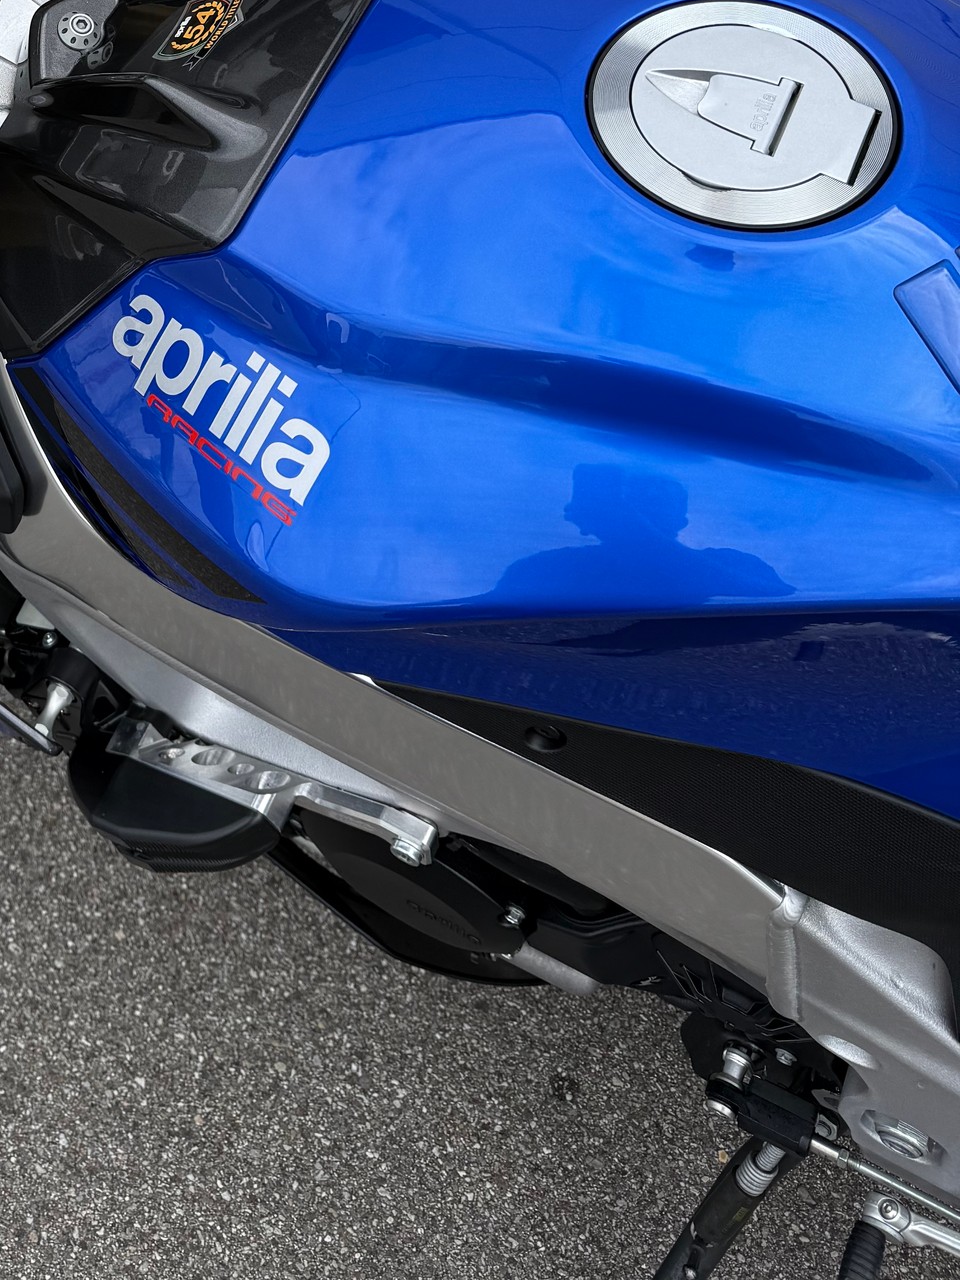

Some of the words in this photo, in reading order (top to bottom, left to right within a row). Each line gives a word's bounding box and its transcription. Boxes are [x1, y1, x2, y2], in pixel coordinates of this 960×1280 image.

[183, 8, 216, 40] 54
[203, 20, 229, 49] WORLD
[749, 93, 778, 132] aprilia
[112, 294, 331, 507] aprilia
